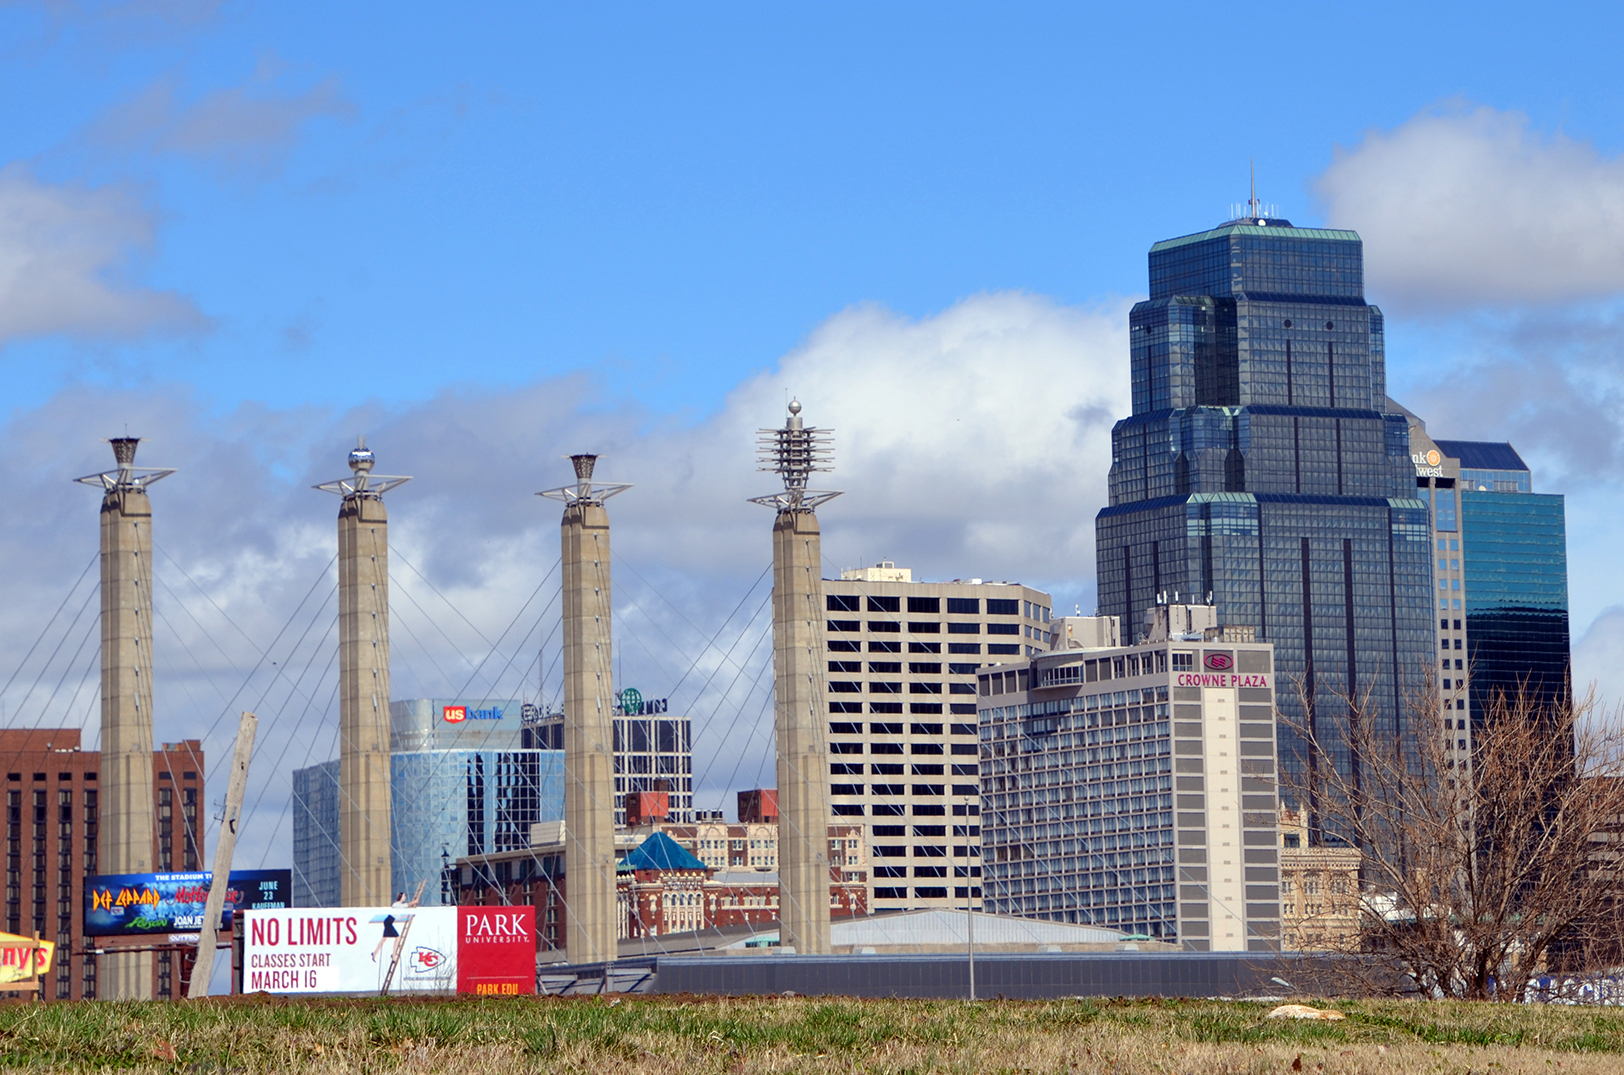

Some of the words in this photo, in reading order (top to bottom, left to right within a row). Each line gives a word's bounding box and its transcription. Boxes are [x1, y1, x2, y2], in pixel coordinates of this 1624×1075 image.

[1178, 674, 1226, 687] CROWNE
[1231, 675, 1267, 688] PLAZA
[258, 881, 279, 891] JUNE
[263, 891, 274, 900] 23
[174, 915, 193, 926] JOAN
[466, 913, 529, 936] PARK
[251, 917, 280, 946] NO
[288, 916, 358, 946] LIMITS
[251, 953, 297, 968] CLASSES
[299, 953, 332, 967] START
[251, 970, 299, 990] MARCH
[304, 969, 317, 989] 16
